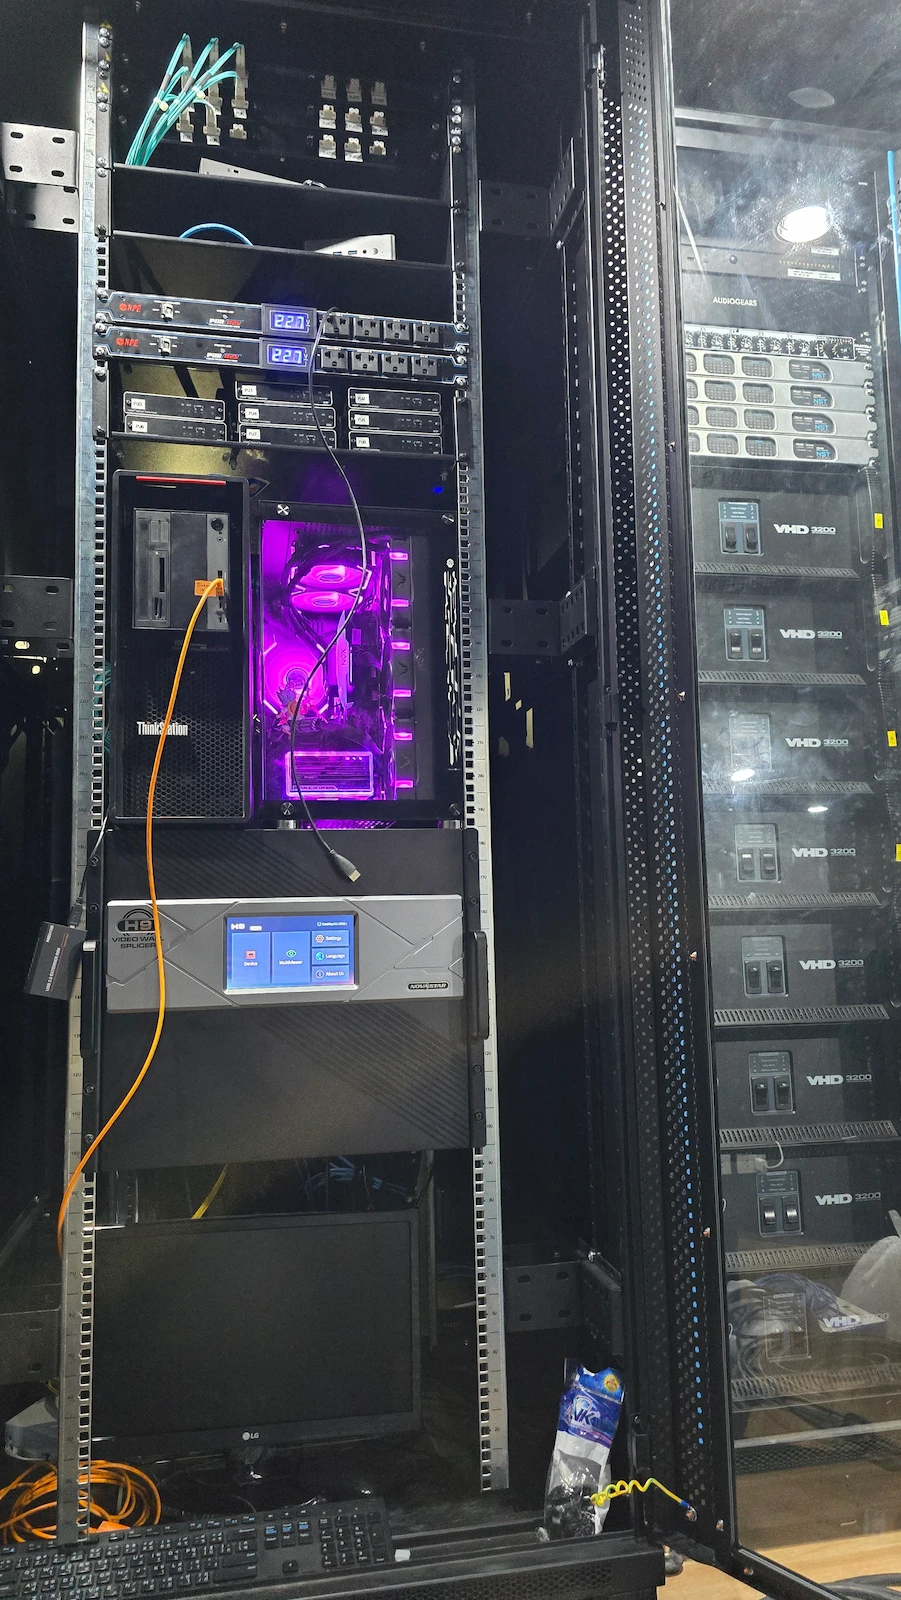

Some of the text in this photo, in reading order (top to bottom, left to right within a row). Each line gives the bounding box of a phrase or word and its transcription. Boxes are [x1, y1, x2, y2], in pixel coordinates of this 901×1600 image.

[712, 296, 758, 306] AUDIOGEARS
[127, 304, 142, 312] NPE
[274, 314, 304, 329] 227
[124, 338, 138, 347] NPE
[272, 348, 302, 364] 227
[773, 524, 809, 534] VHD
[780, 629, 815, 639] VHD
[136, 721, 188, 736] ThinkSation
[785, 738, 821, 747] VHD
[792, 848, 828, 858] VHD
[124, 920, 152, 931] H9
[799, 959, 836, 970] VHD
[806, 1074, 843, 1085] VHD
[815, 1194, 852, 1205] VHD
[822, 1315, 861, 1327] VHD
